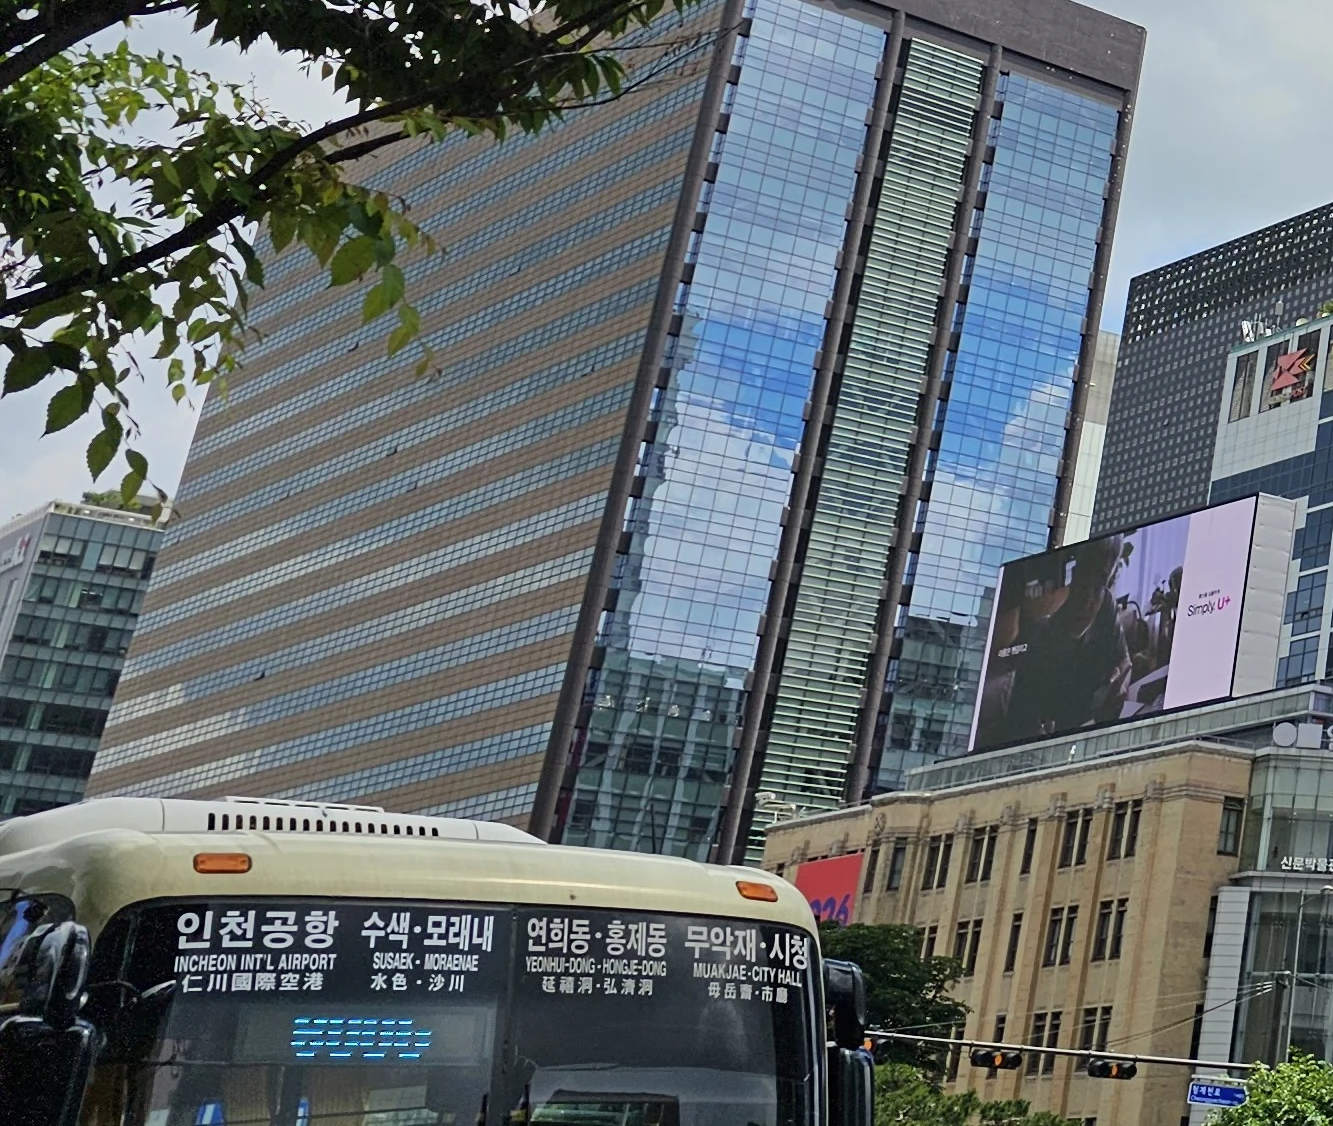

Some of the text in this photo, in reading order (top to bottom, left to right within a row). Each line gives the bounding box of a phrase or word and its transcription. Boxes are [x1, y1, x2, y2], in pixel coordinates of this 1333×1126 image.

[1217, 595, 1232, 611] U+
[176, 910, 340, 950] 인천공항
[173, 953, 338, 974] INCHEON INT'L AIRPORT
[181, 972, 324, 993] 仁川國際空港
[777, 970, 803, 988] HALL
